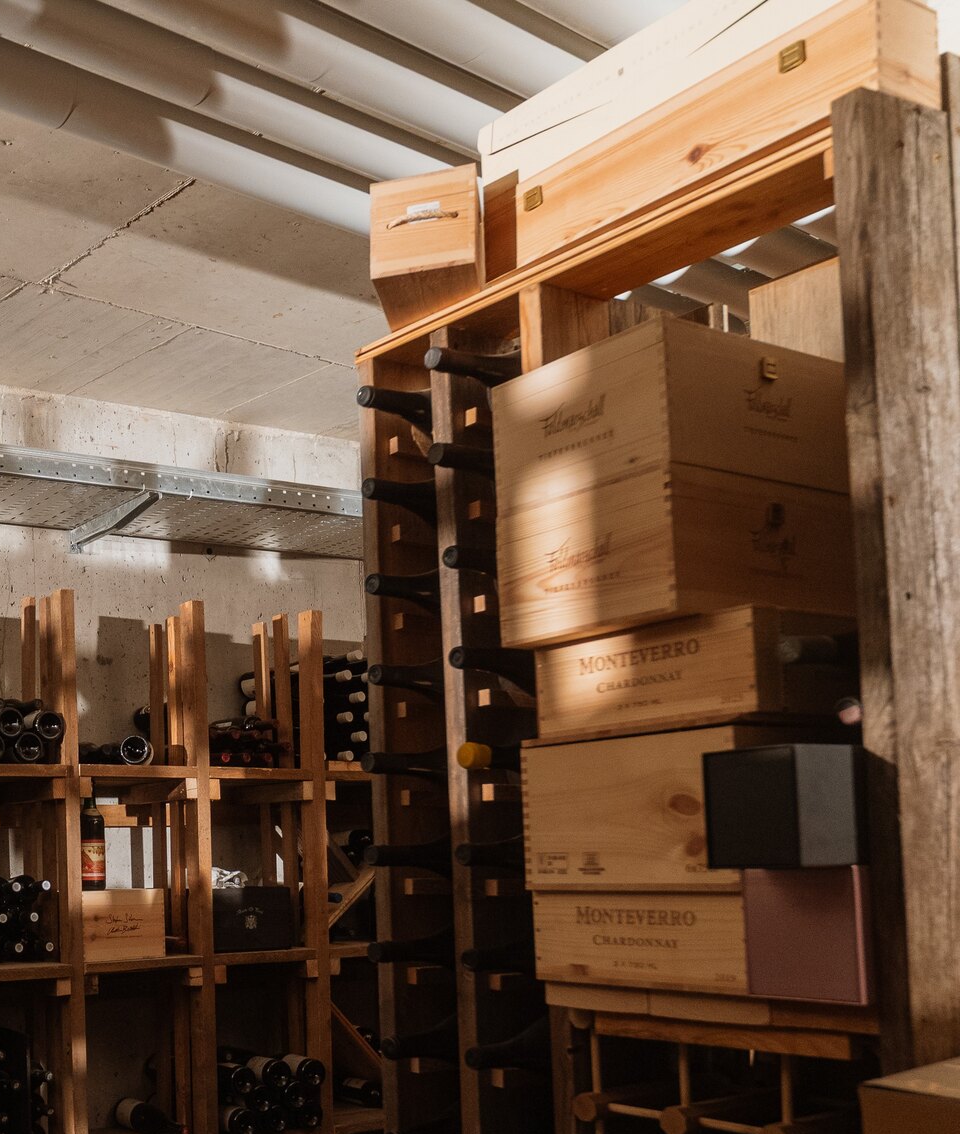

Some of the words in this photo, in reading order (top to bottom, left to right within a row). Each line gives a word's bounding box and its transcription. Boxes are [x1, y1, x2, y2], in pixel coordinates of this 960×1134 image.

[578, 638, 700, 676] MONTEVERRO
[596, 671, 682, 694] CHARDONNAY
[576, 906, 697, 927] MONTEVERRO
[592, 934, 678, 949] CHARDONNAY
